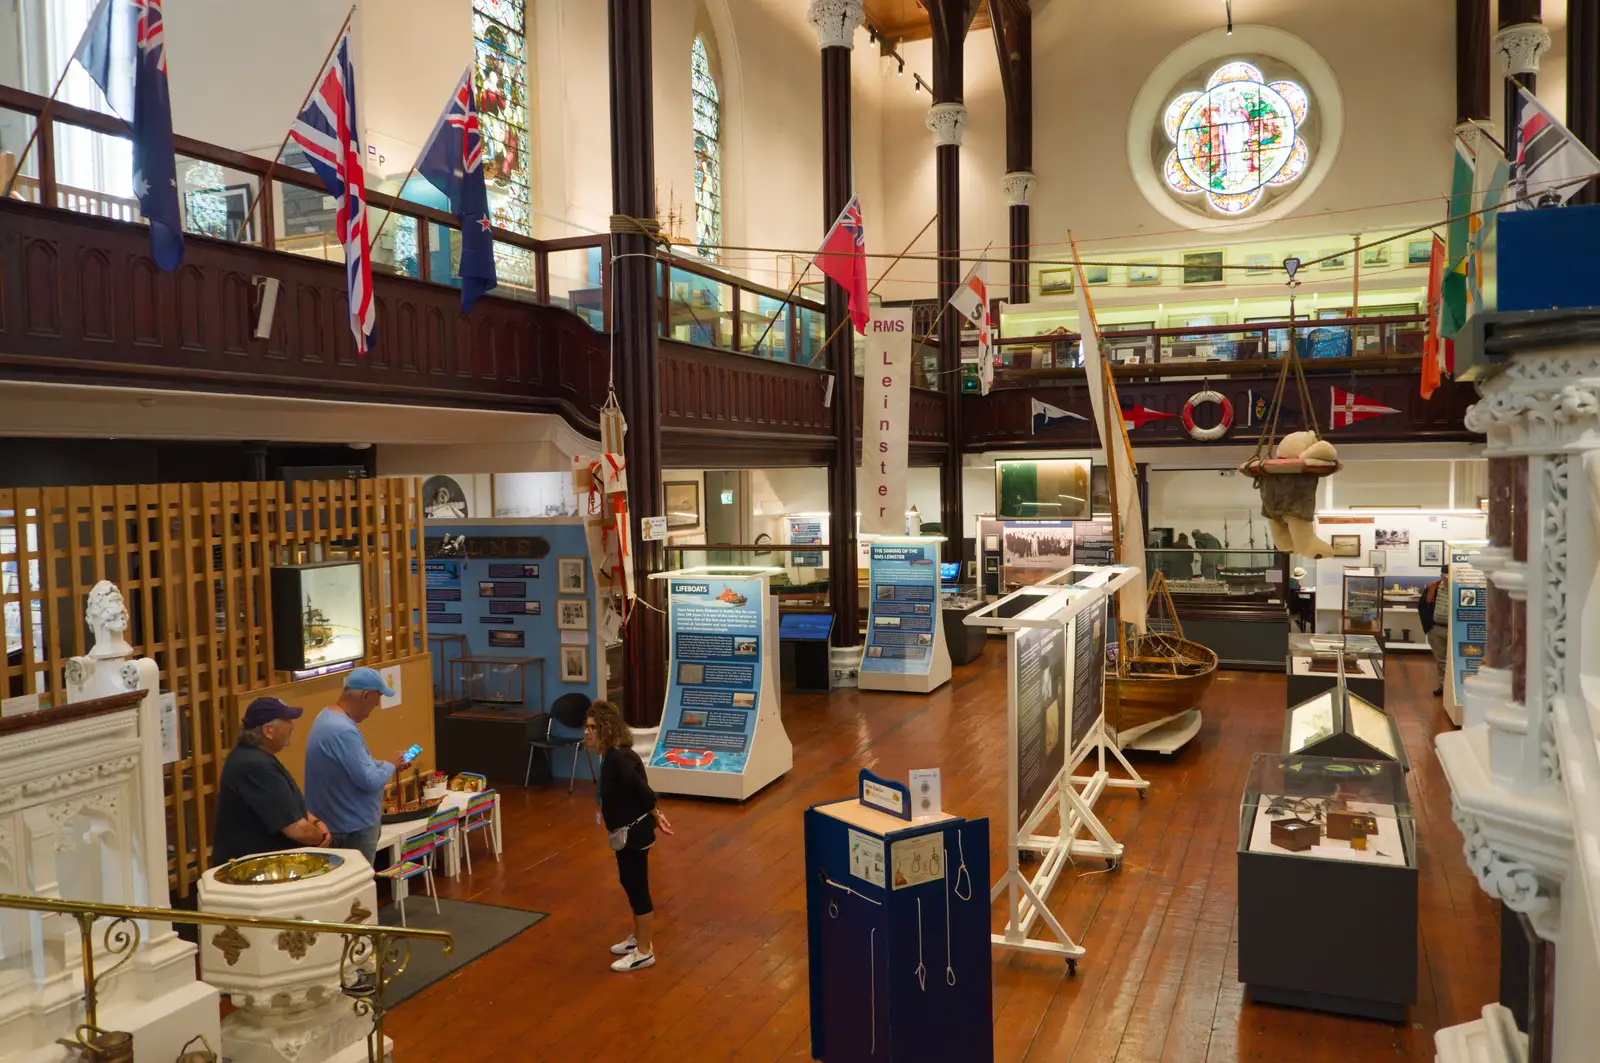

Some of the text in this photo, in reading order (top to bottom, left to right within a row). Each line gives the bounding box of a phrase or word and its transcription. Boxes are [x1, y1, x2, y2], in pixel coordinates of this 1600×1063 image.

[379, 155, 385, 166] P
[873, 319, 905, 332] RMS
[878, 351, 893, 518] Leinster
[1441, 520, 1448, 529] E
